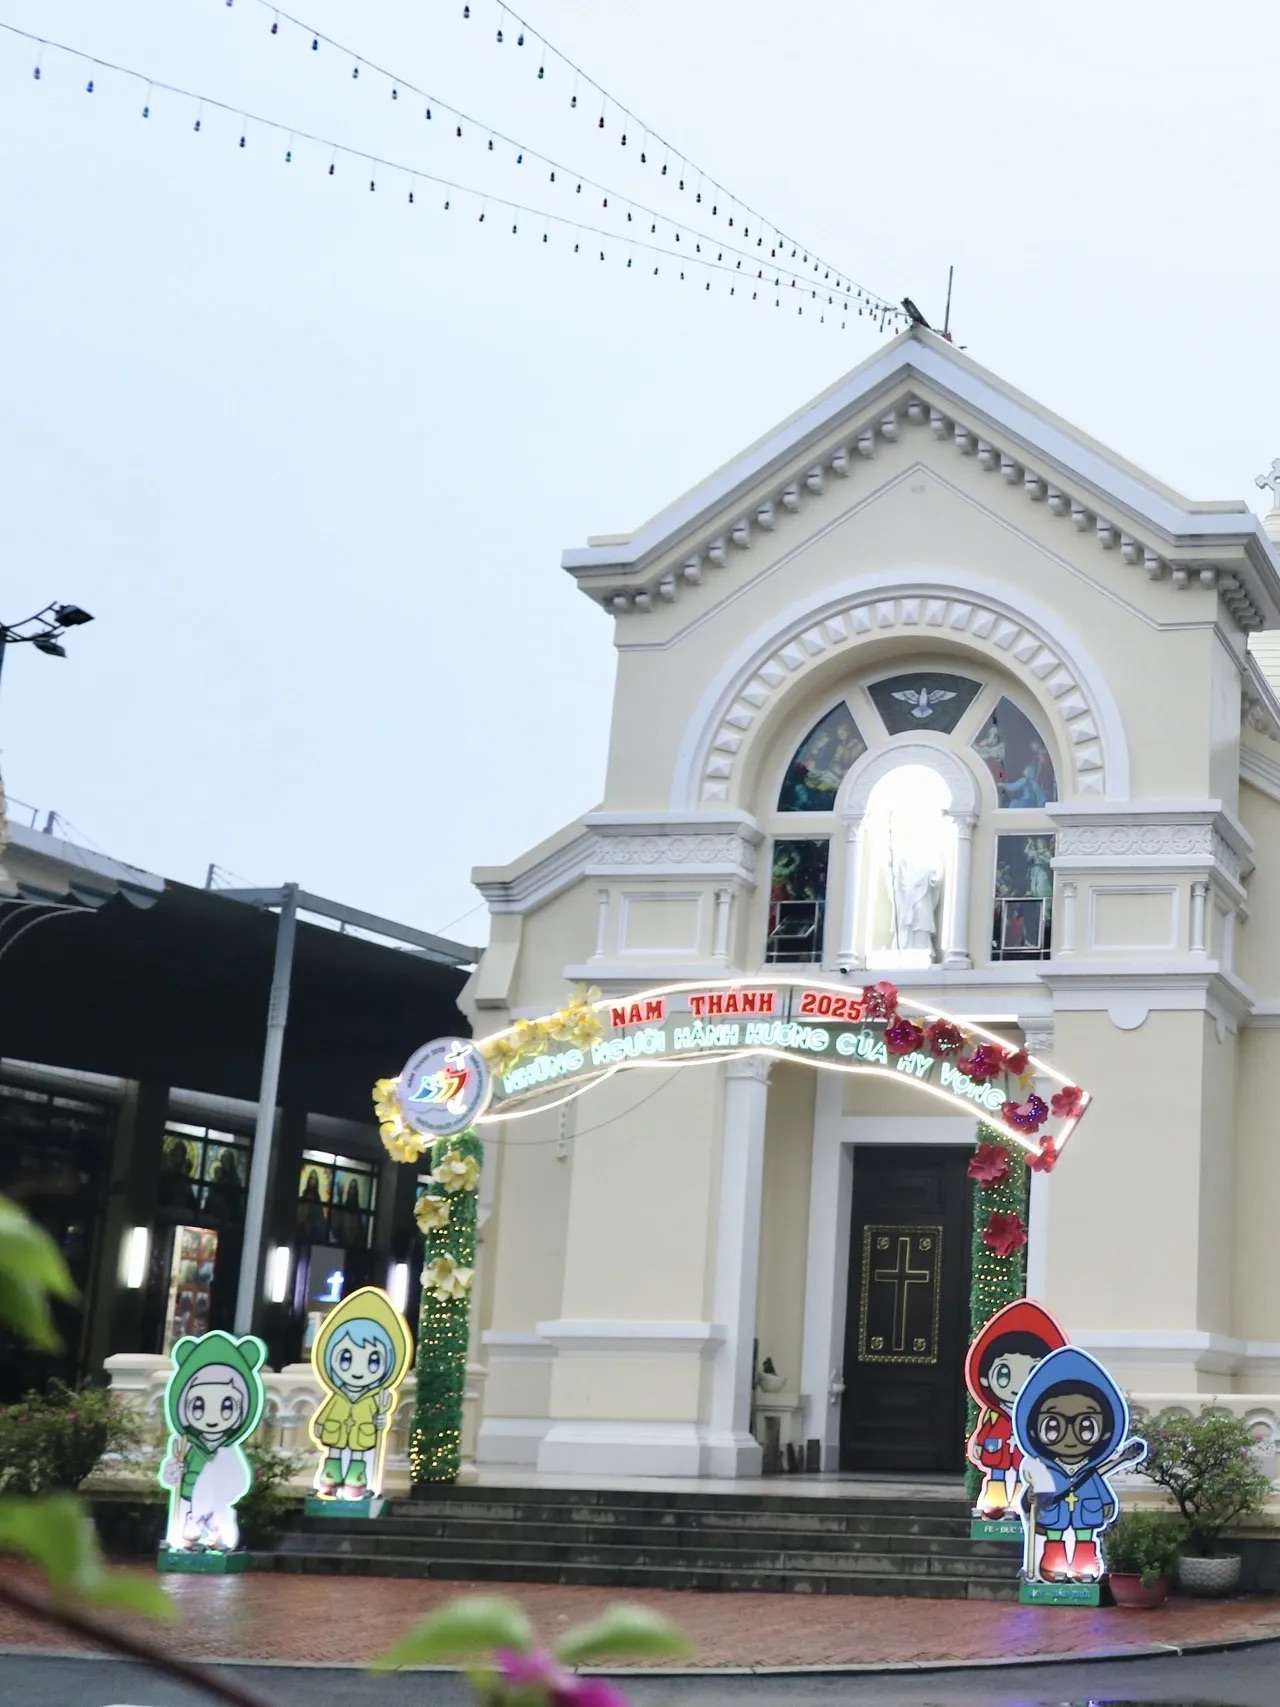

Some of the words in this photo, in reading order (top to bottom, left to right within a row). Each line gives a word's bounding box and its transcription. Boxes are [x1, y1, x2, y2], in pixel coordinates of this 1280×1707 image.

[690, 987, 775, 1016] THÁNH
[799, 994, 866, 1023] 2025
[896, 1051, 933, 1078] HY
